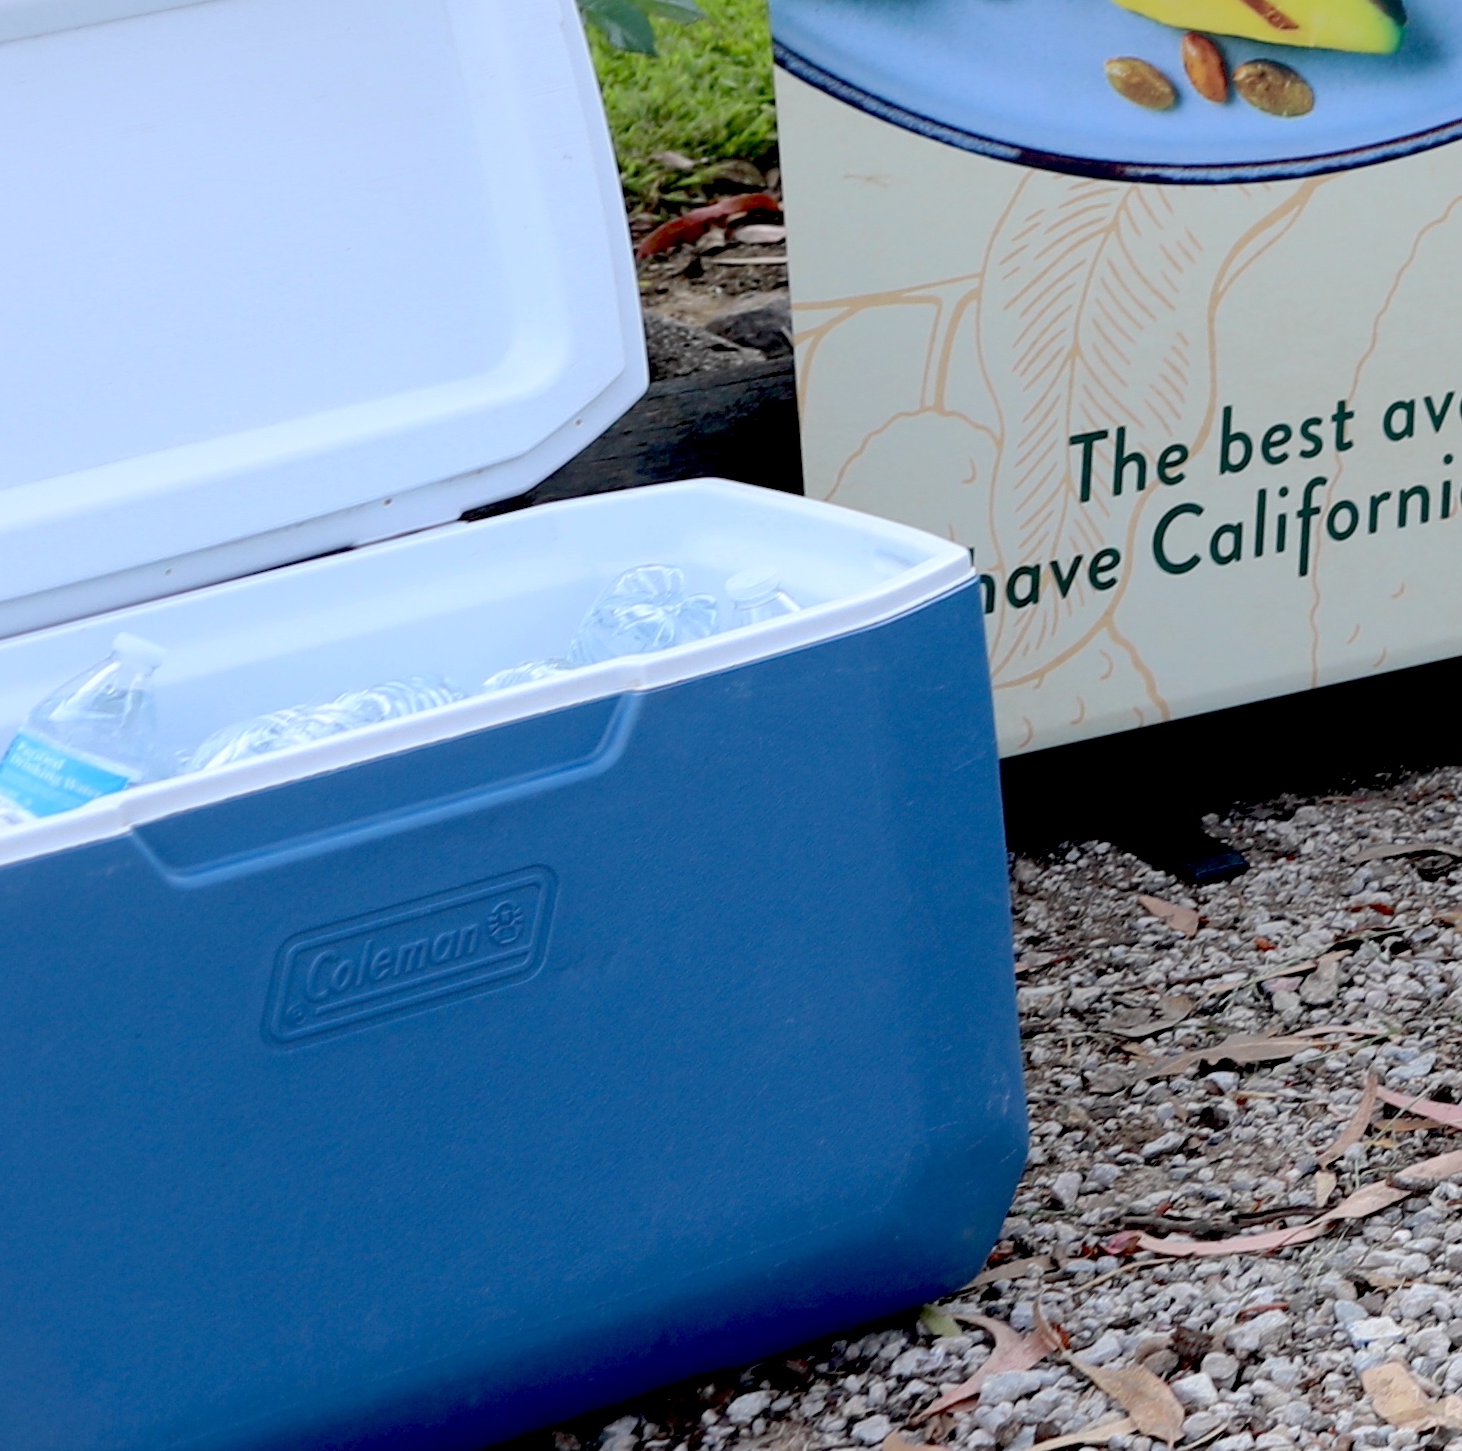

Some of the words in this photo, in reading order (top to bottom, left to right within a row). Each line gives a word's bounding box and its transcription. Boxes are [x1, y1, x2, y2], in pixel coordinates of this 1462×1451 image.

[1069, 426, 1191, 503] The
[1219, 406, 1355, 475] best
[307, 922, 479, 1004] Coleman
